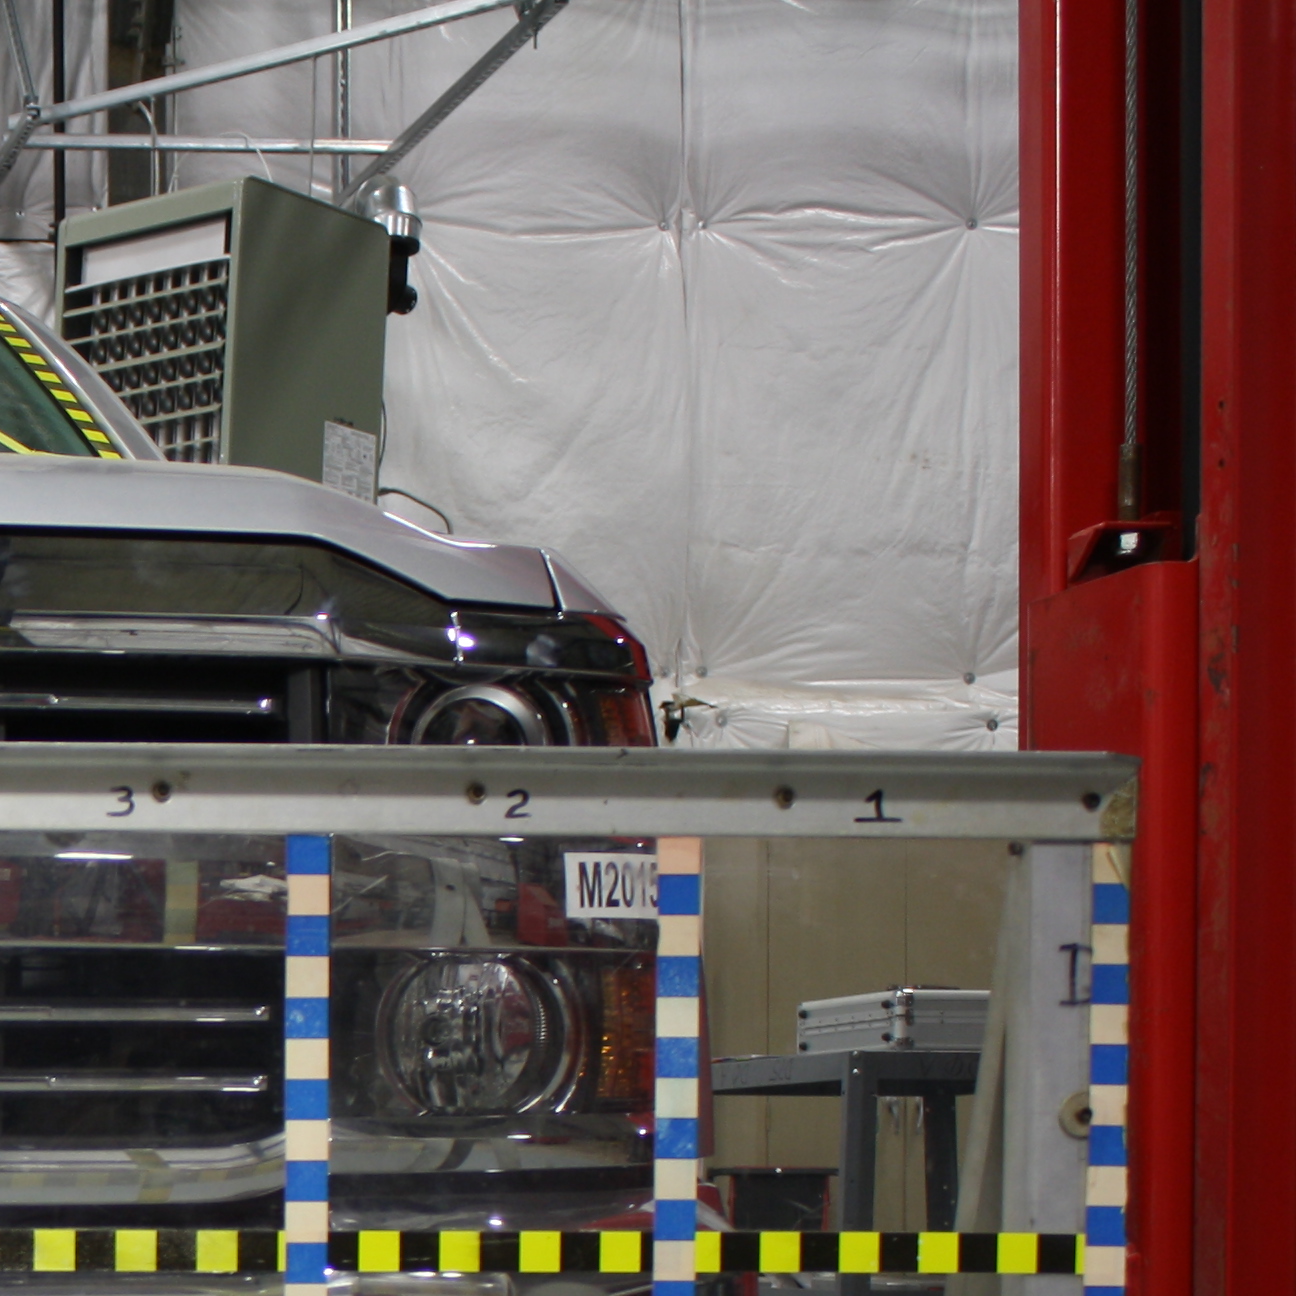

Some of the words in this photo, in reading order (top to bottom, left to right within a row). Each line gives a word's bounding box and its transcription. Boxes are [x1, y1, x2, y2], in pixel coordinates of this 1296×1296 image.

[107, 784, 138, 819] 3
[506, 788, 532, 819] 2
[853, 789, 902, 823] 1
